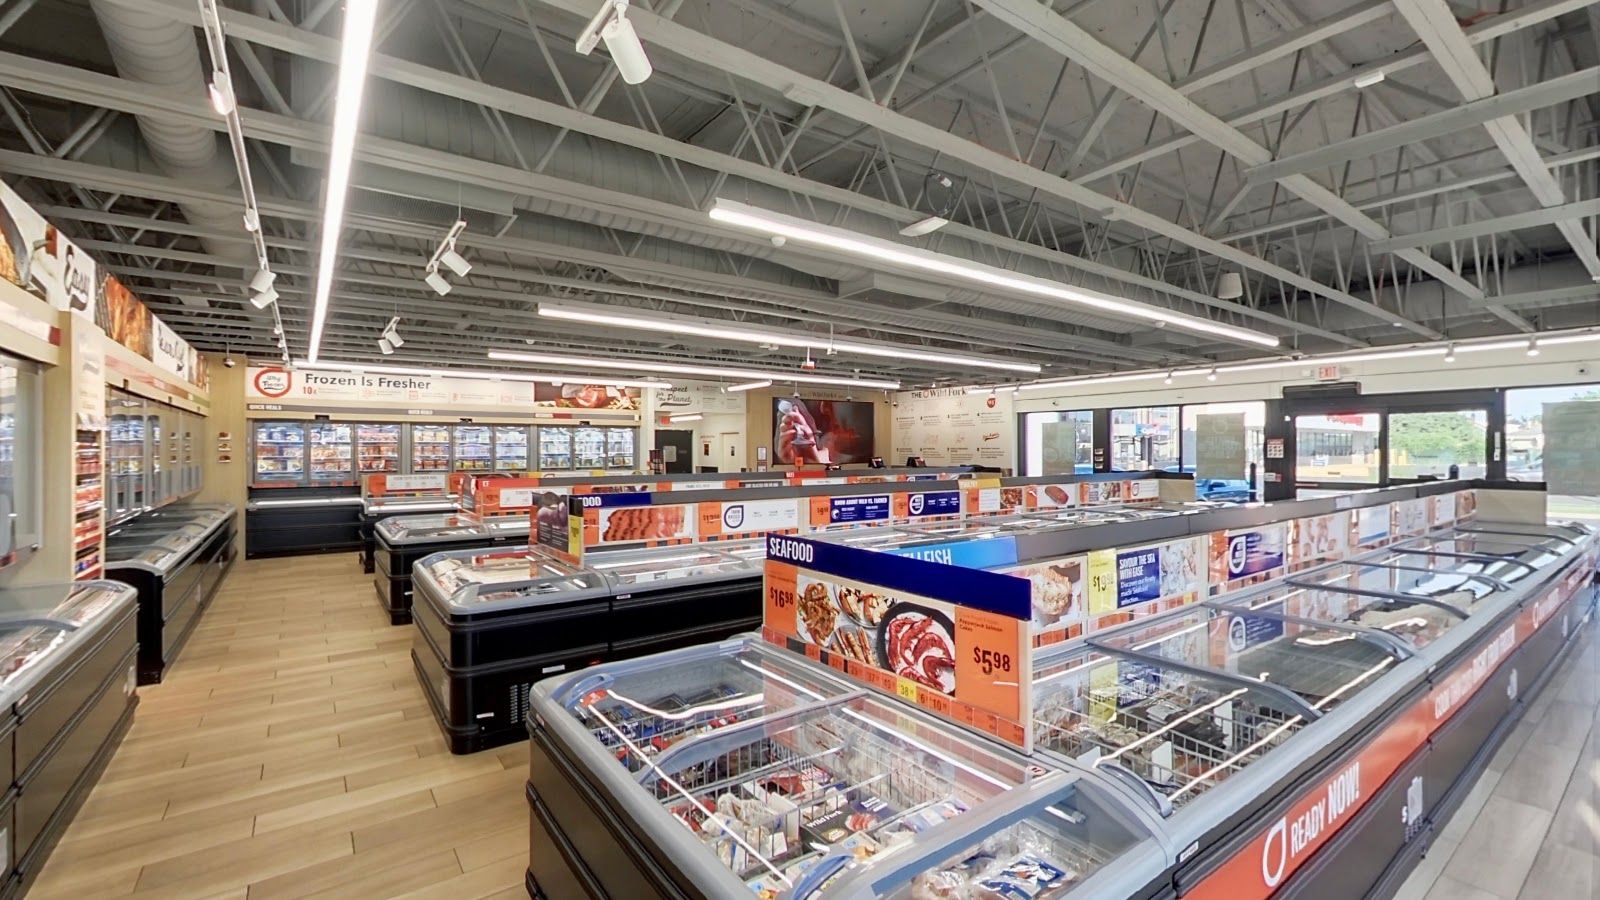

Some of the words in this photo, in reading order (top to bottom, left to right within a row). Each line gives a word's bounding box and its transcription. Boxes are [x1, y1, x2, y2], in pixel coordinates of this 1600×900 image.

[1319, 366, 1336, 378] EXIT
[305, 373, 356, 386] Frozen
[361, 376, 373, 387] Is
[379, 377, 431, 390] Fresher
[667, 394, 692, 403] Planet
[911, 391, 922, 399] THE
[770, 537, 813, 563] SEAFOOD
[1138, 554, 1147, 566] THE
[1147, 552, 1156, 564] SEA
[1119, 568, 1133, 580] WITH
[1133, 565, 1144, 578] EASE
[1291, 798, 1326, 858] READY
[1327, 761, 1360, 825] NOW!
